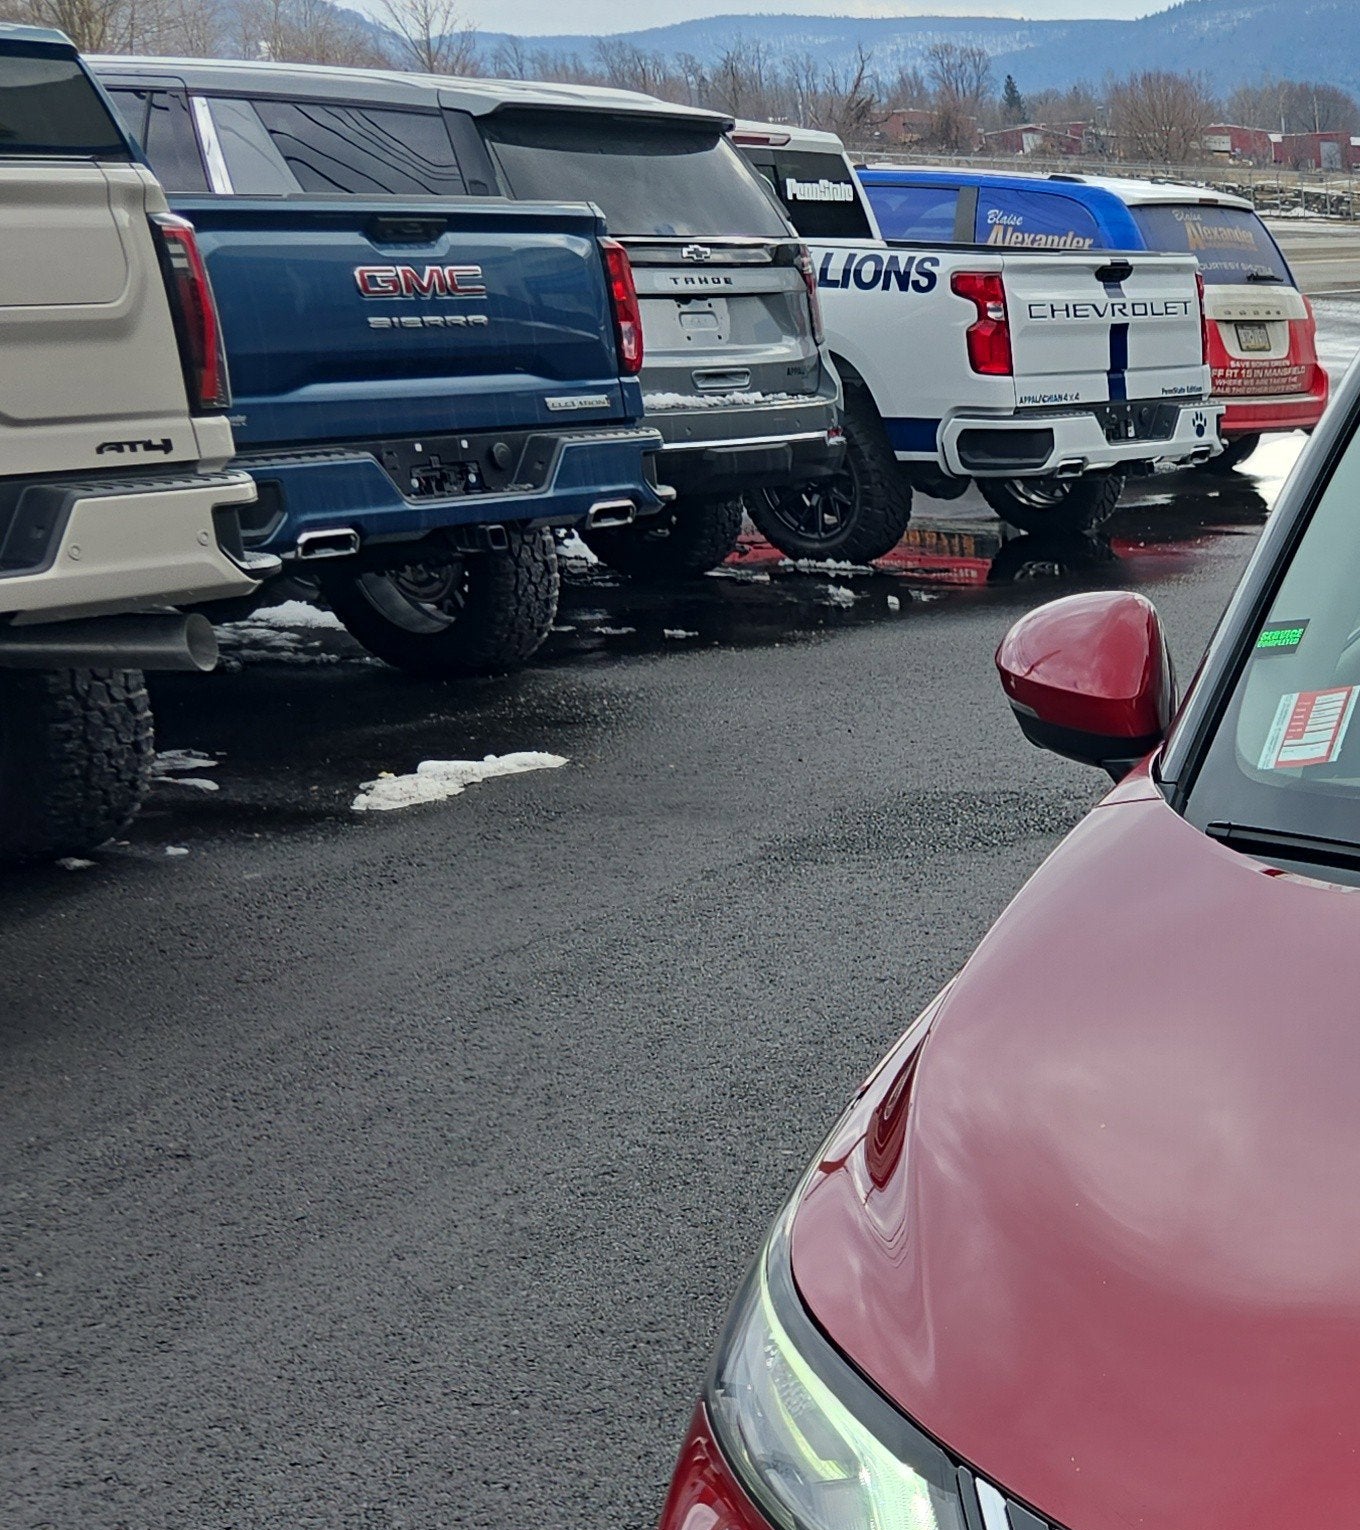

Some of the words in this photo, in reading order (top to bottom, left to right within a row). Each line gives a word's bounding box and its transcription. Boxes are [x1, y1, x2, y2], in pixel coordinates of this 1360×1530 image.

[785, 178, 854, 201] PennState
[987, 209, 1024, 226] Blaise
[987, 225, 1094, 249] Alexander
[1185, 221, 1257, 247] Alexander
[817, 252, 940, 294] LIONS
[1199, 261, 1239, 271] OURTESY
[354, 265, 487, 298] GMC
[669, 276, 734, 286] TAHOE
[1028, 300, 1192, 319] CHEVROLET
[367, 314, 489, 329] SIERRA
[1211, 368, 1224, 378] FF
[1225, 368, 1239, 378] RT
[95, 438, 174, 455] AT4
